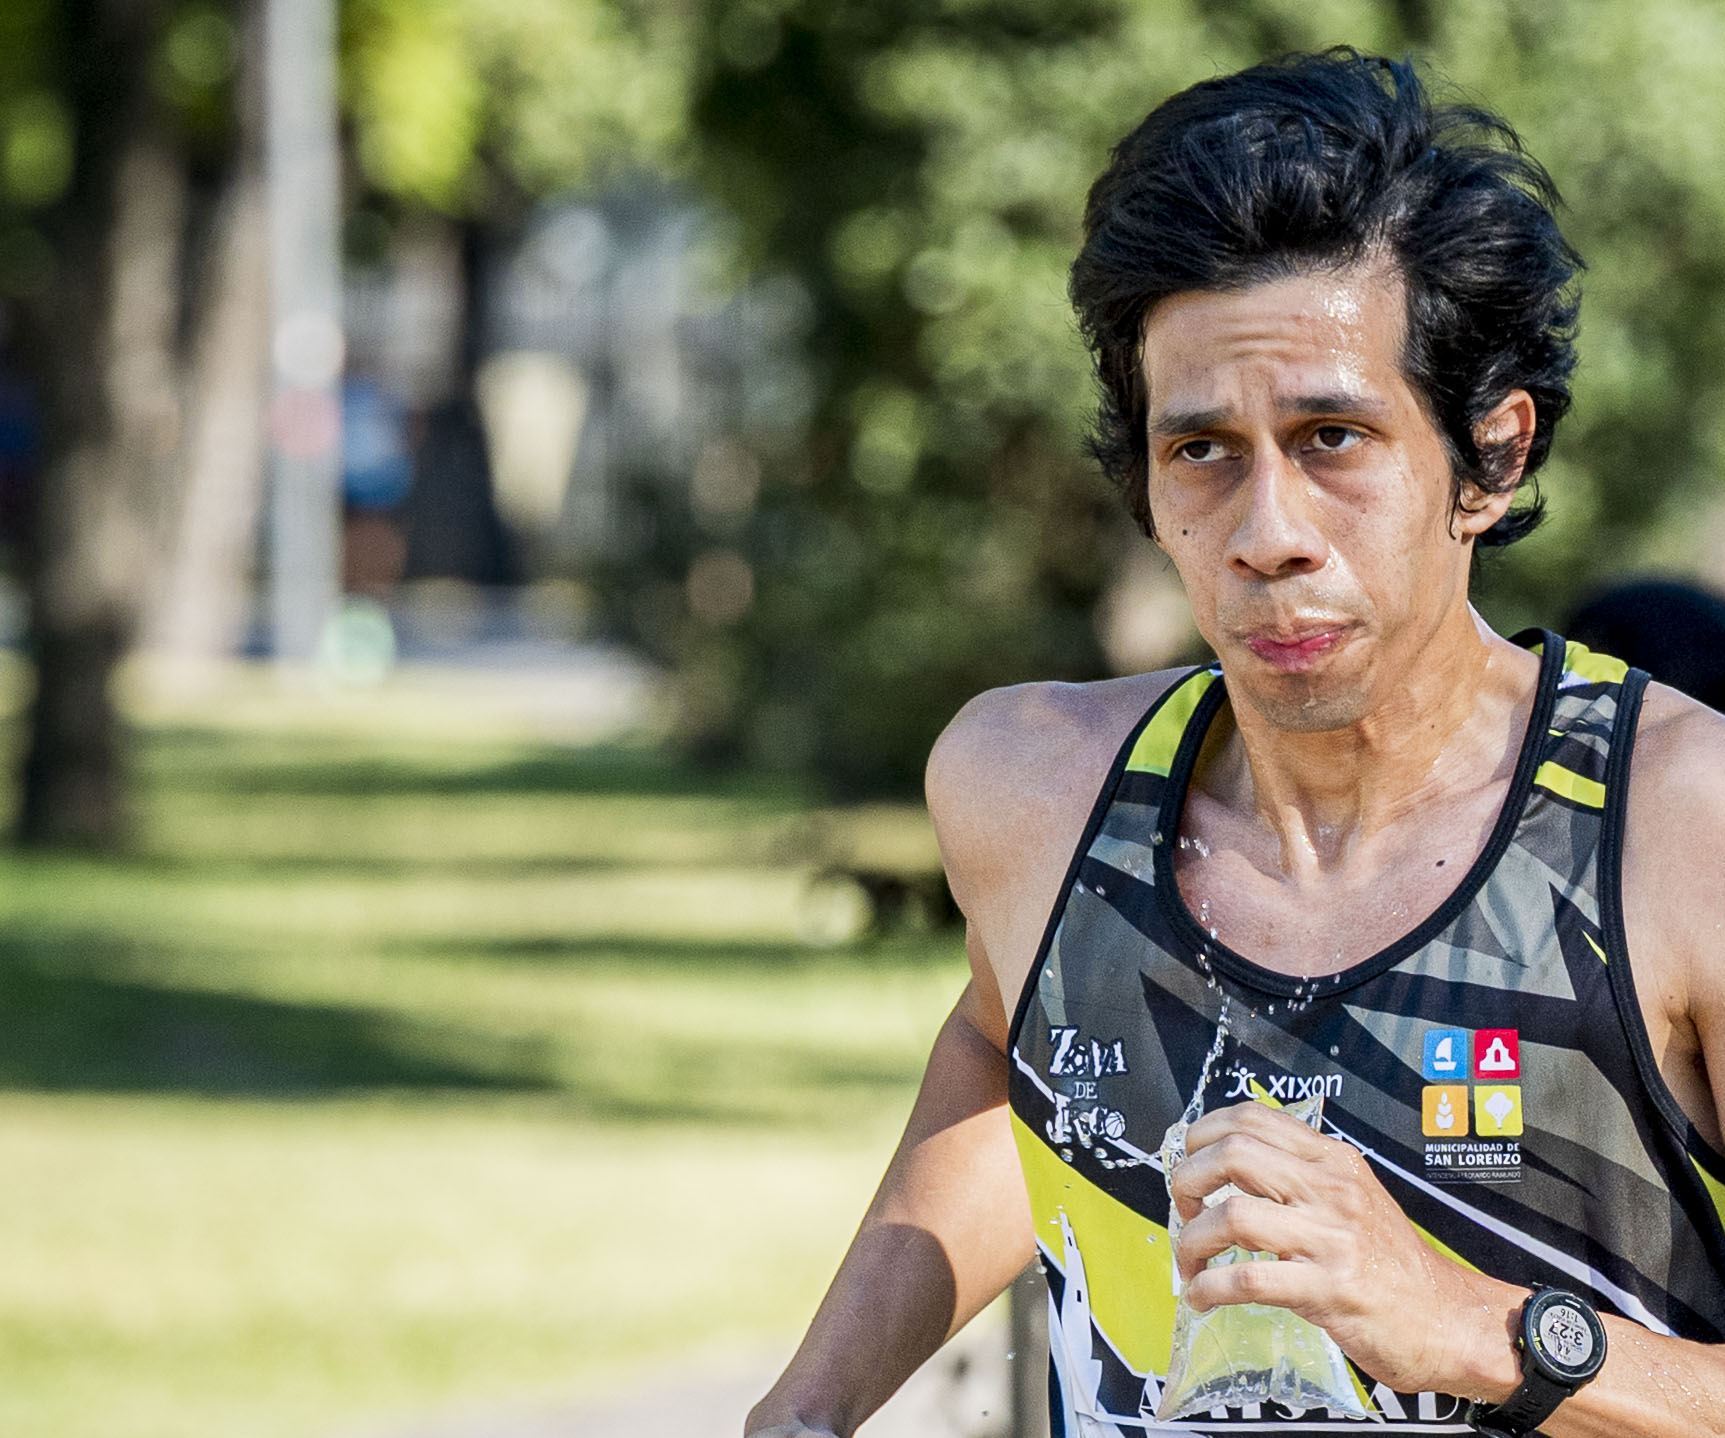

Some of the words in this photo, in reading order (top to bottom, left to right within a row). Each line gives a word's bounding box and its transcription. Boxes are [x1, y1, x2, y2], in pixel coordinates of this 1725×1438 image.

[1074, 1081, 1098, 1099] DE
[1425, 1143, 1503, 1153] MUNICIPALIDAD
[1506, 1142, 1520, 1152] DE
[1424, 1154, 1452, 1166] SAN
[1458, 1153, 1521, 1166] LORENZO
